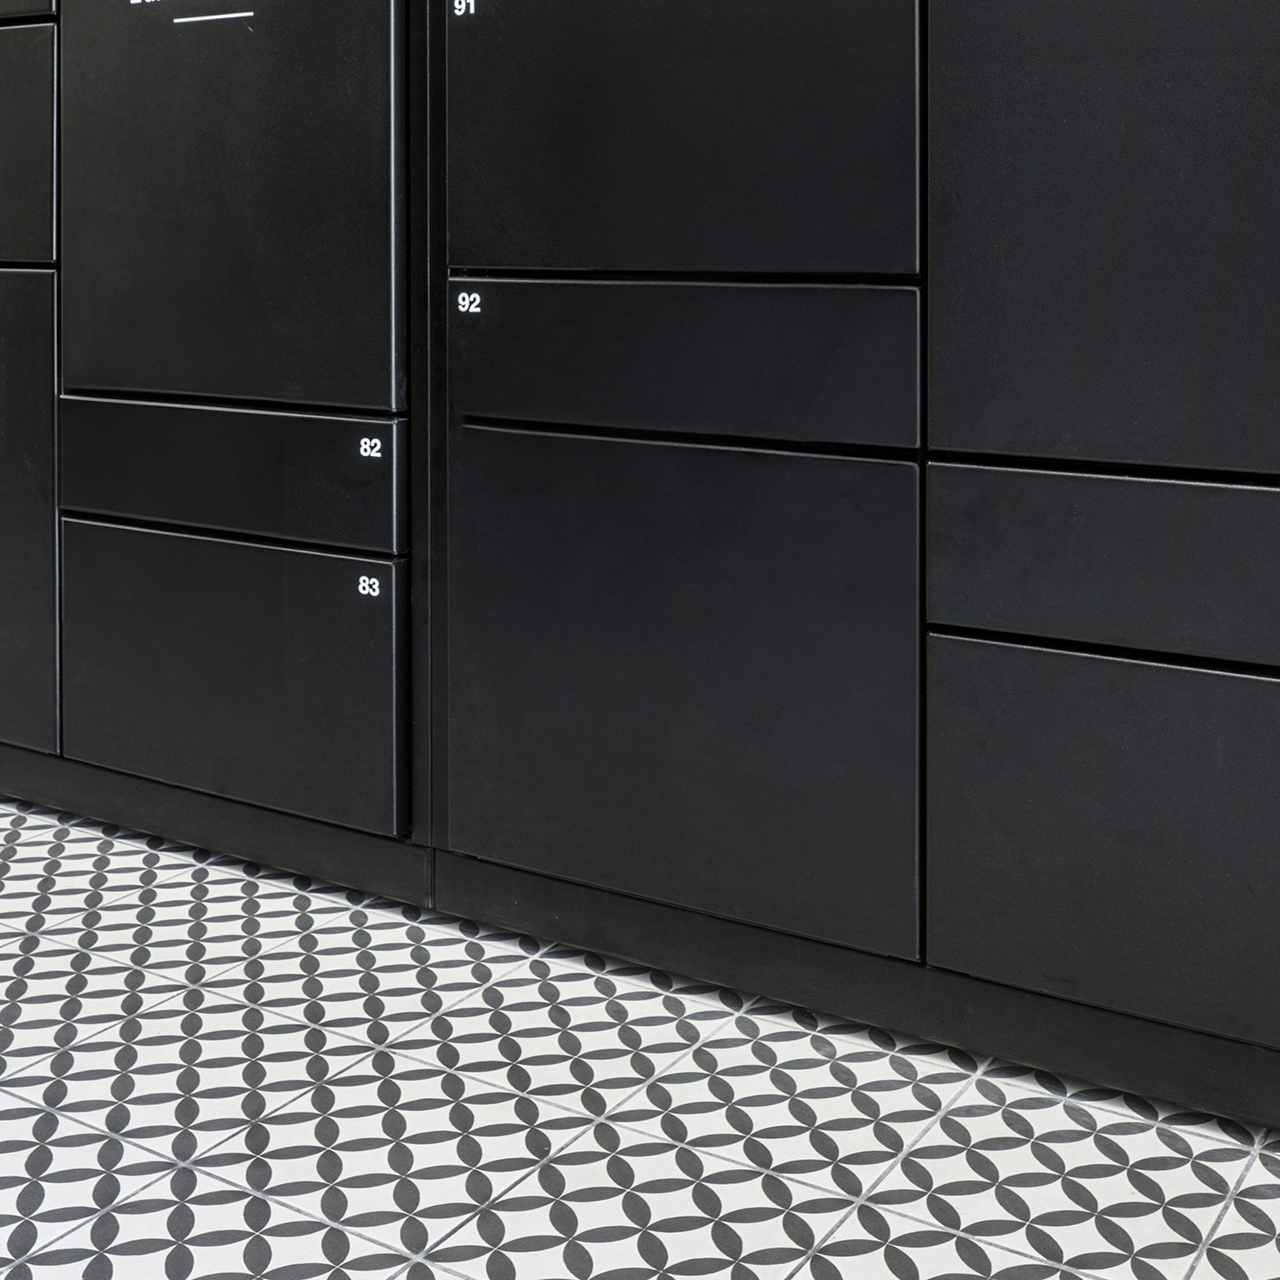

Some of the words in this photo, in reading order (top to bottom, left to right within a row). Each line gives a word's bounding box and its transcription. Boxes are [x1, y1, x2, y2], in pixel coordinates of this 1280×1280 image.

[457, 291, 482, 314] 92
[359, 437, 383, 458] 82
[357, 575, 381, 597] 83
